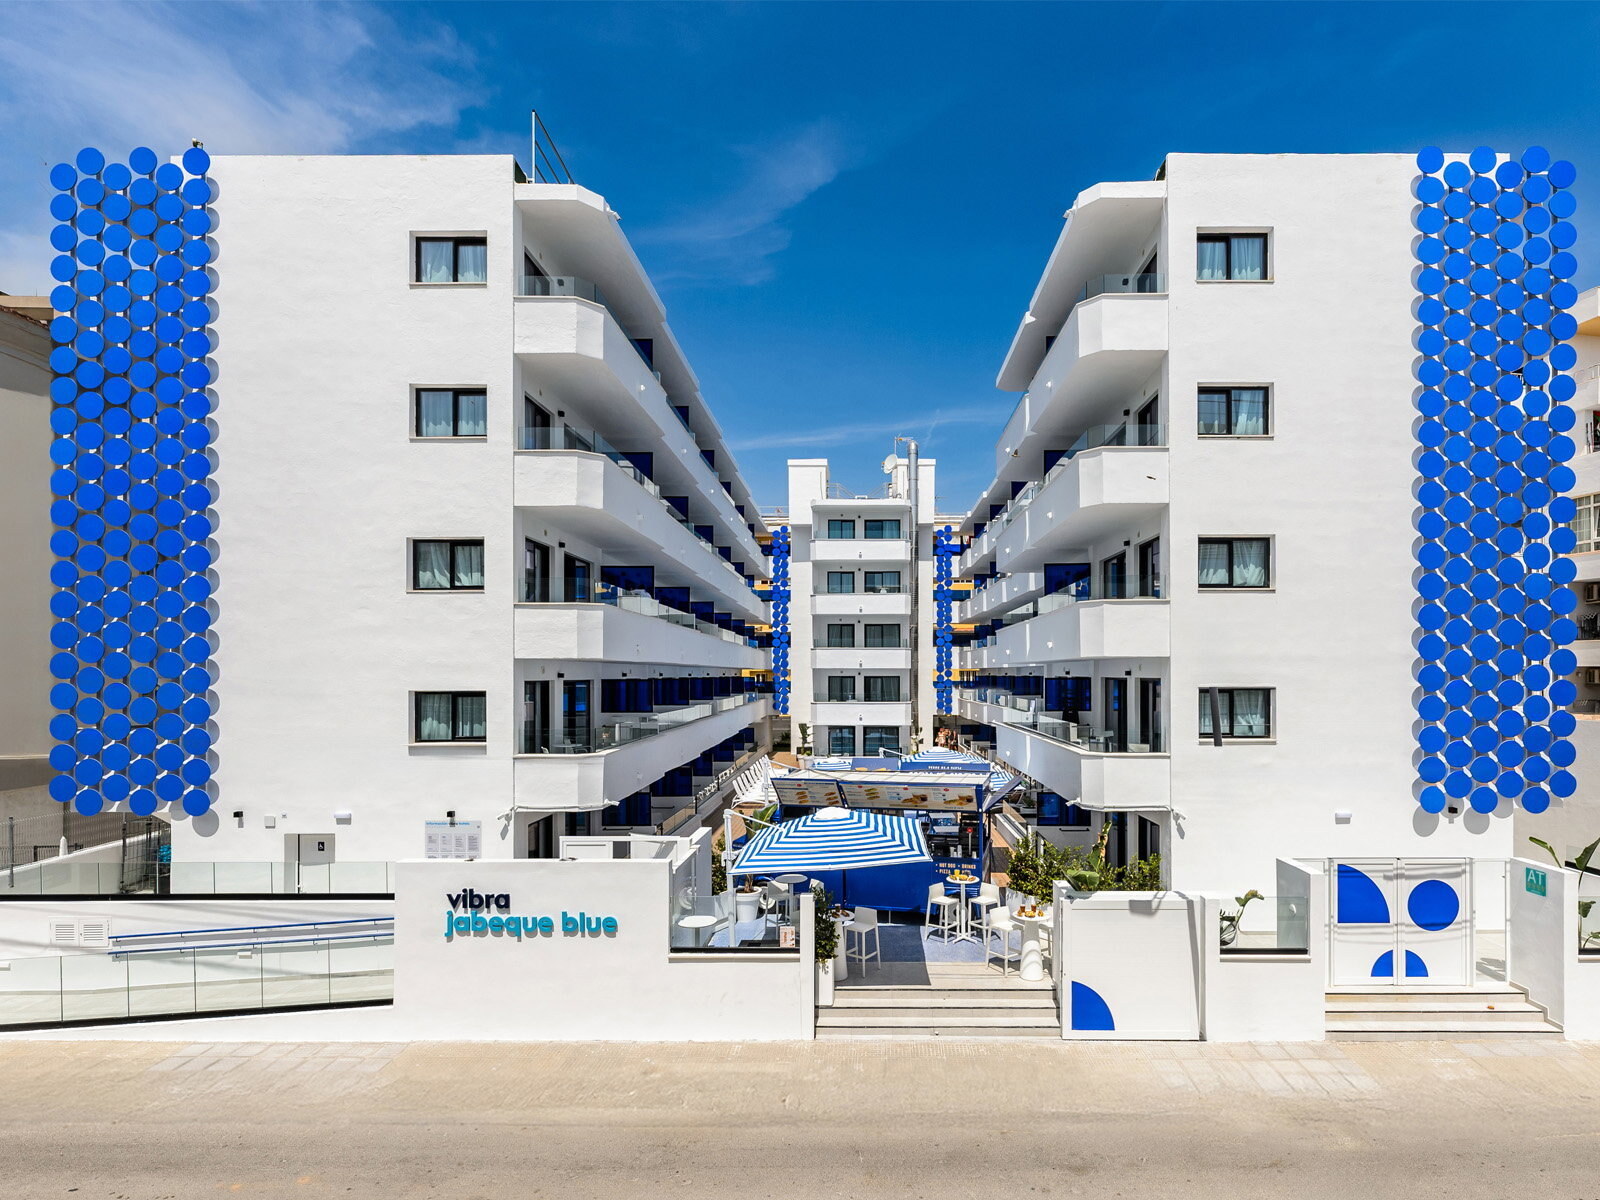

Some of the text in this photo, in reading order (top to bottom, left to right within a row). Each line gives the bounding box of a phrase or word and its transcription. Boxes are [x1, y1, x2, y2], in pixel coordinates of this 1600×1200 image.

[1528, 870, 1545, 885] AT
[446, 888, 510, 909] vibra
[444, 910, 618, 938] jabeque blue
